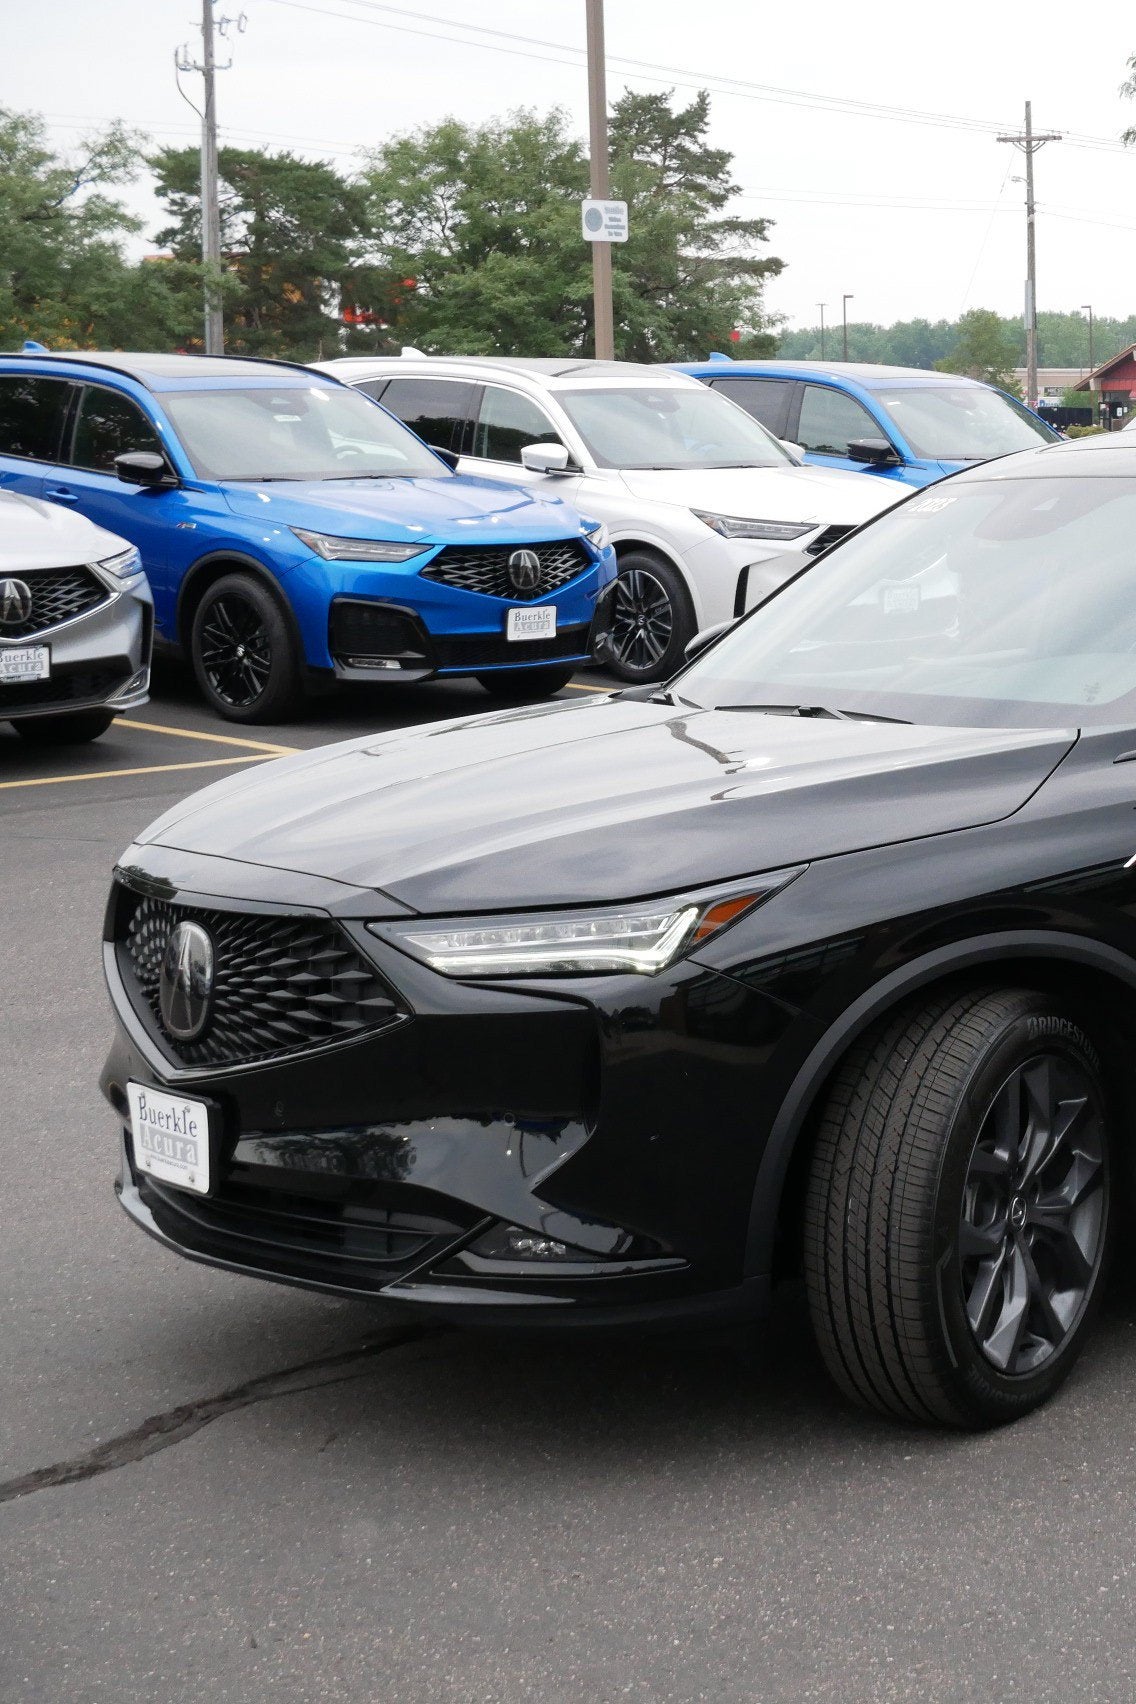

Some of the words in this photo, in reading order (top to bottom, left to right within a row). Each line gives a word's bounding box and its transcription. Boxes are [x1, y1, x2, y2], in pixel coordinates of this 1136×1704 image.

[514, 610, 550, 621] Buerkle
[515, 620, 550, 631] Acura
[137, 1094, 198, 1138] Buerkle
[142, 1125, 197, 1163] Acura
